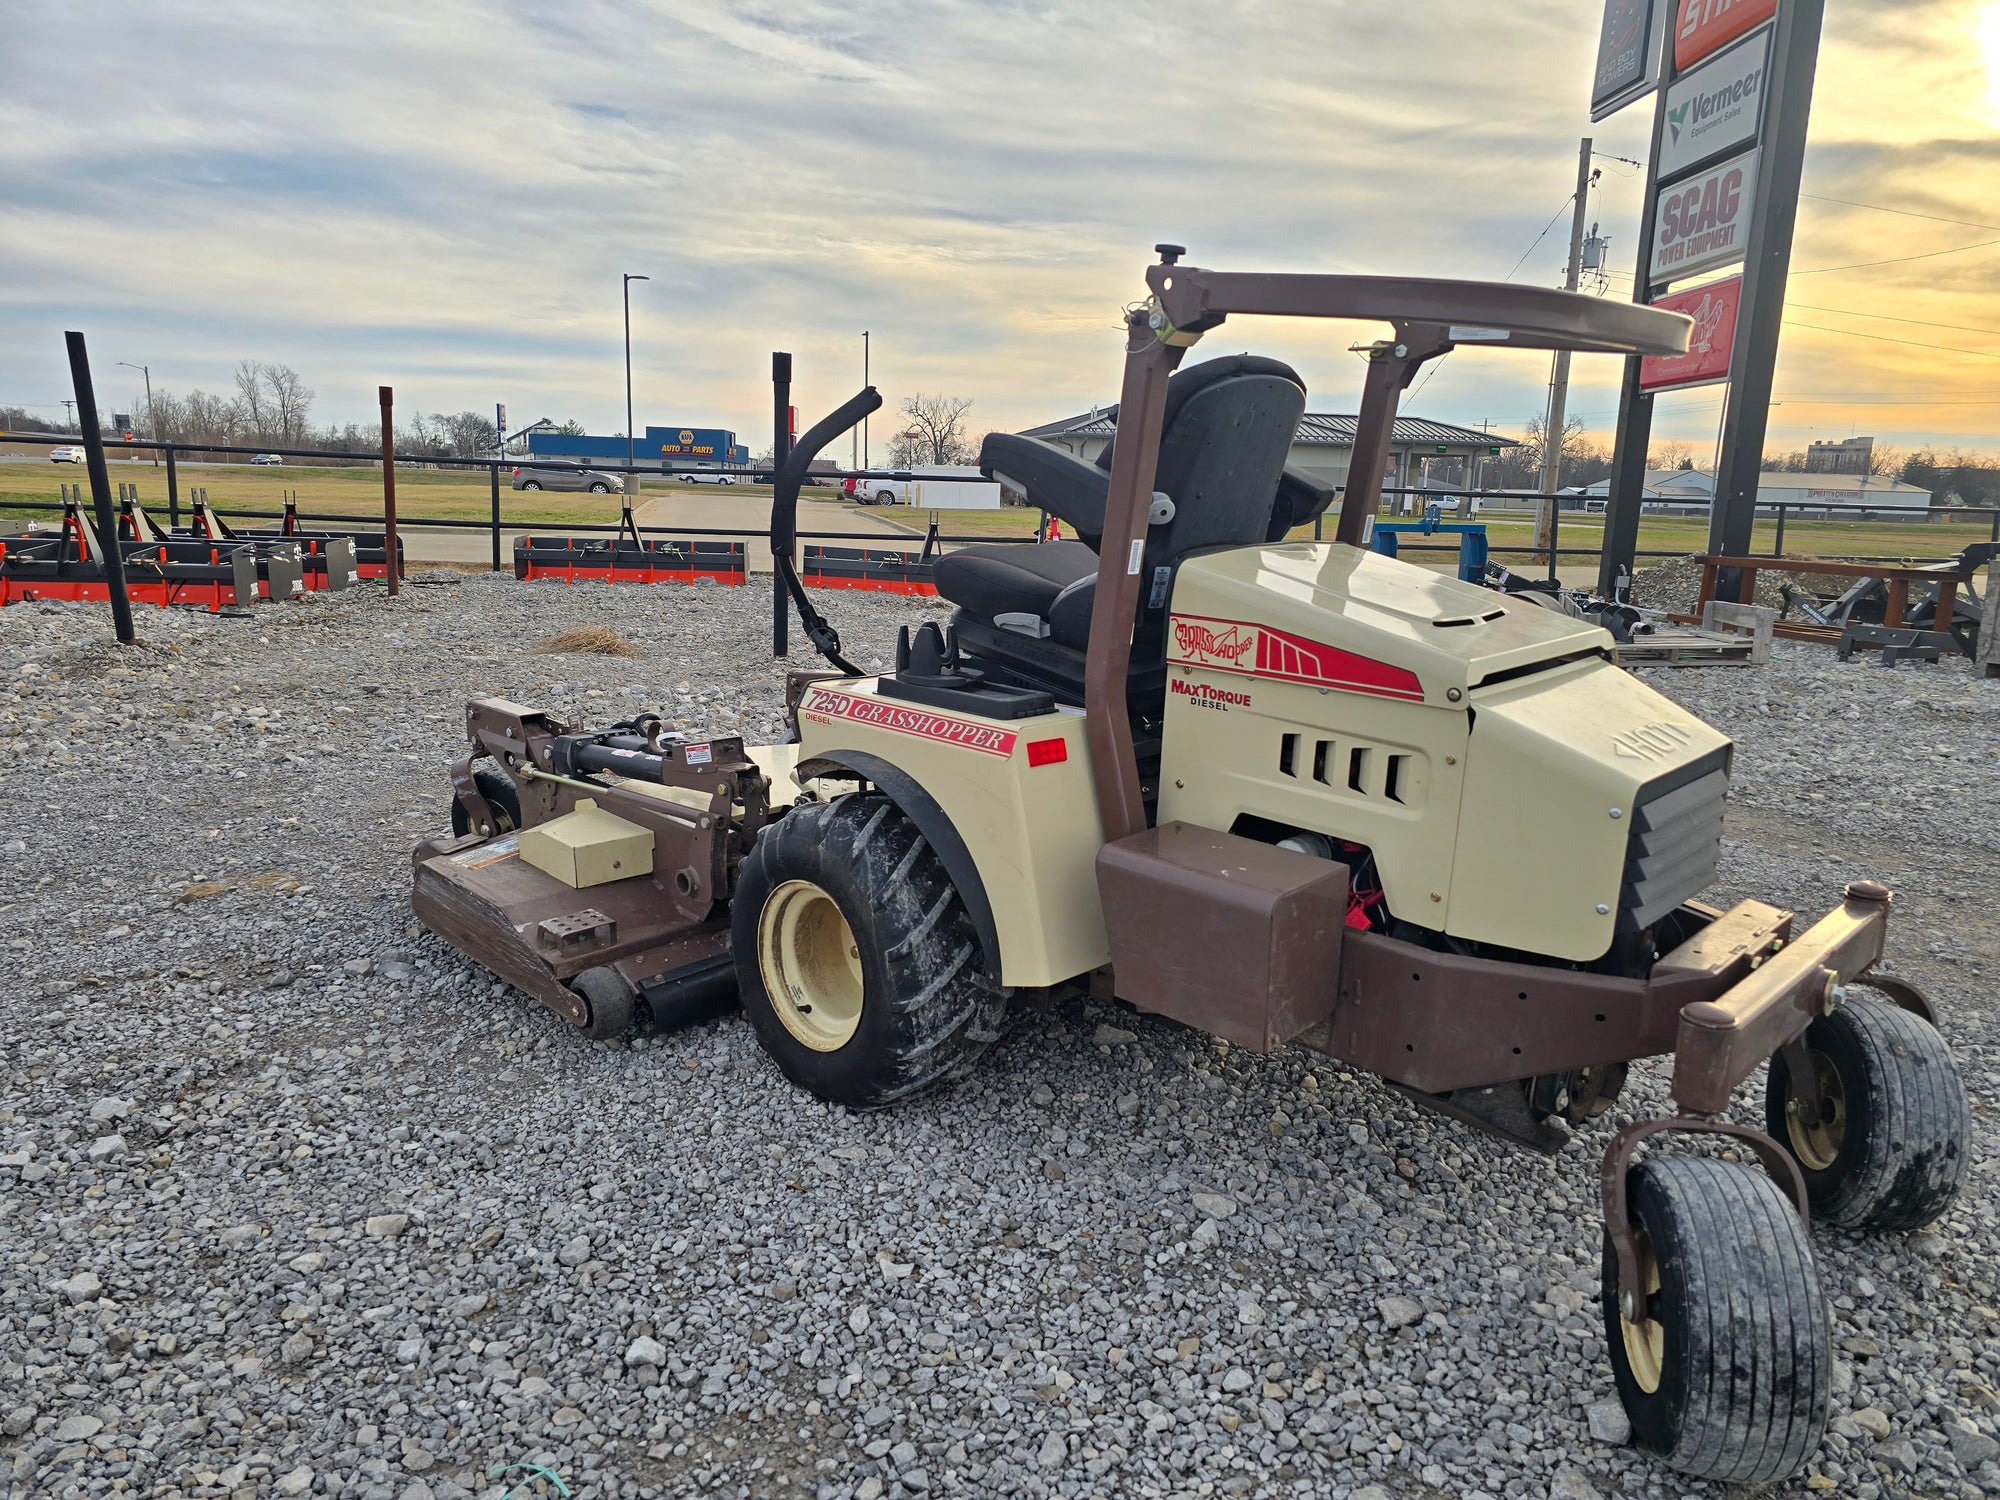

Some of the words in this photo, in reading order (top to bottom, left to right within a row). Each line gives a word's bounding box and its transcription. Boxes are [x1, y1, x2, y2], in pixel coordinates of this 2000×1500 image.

[1599, 60, 1616, 77] BAD
[1617, 46, 1637, 65] BOY
[1691, 68, 1761, 124] Vermeer
[1690, 115, 1723, 139] Equipment
[1724, 106, 1742, 122] Sales
[1661, 168, 1742, 245] SCAG
[1657, 240, 1684, 268] POWER
[1686, 223, 1737, 259] EQUIPMENT
[661, 444, 681, 453] AUTO
[692, 446, 714, 454] PARTS
[681, 433, 692, 441] NAPA
[805, 713, 832, 726] DIESEL
[806, 690, 850, 715] 725D
[854, 702, 1005, 749] GRASSHOPPER
[1190, 696, 1229, 711] DIESEL
